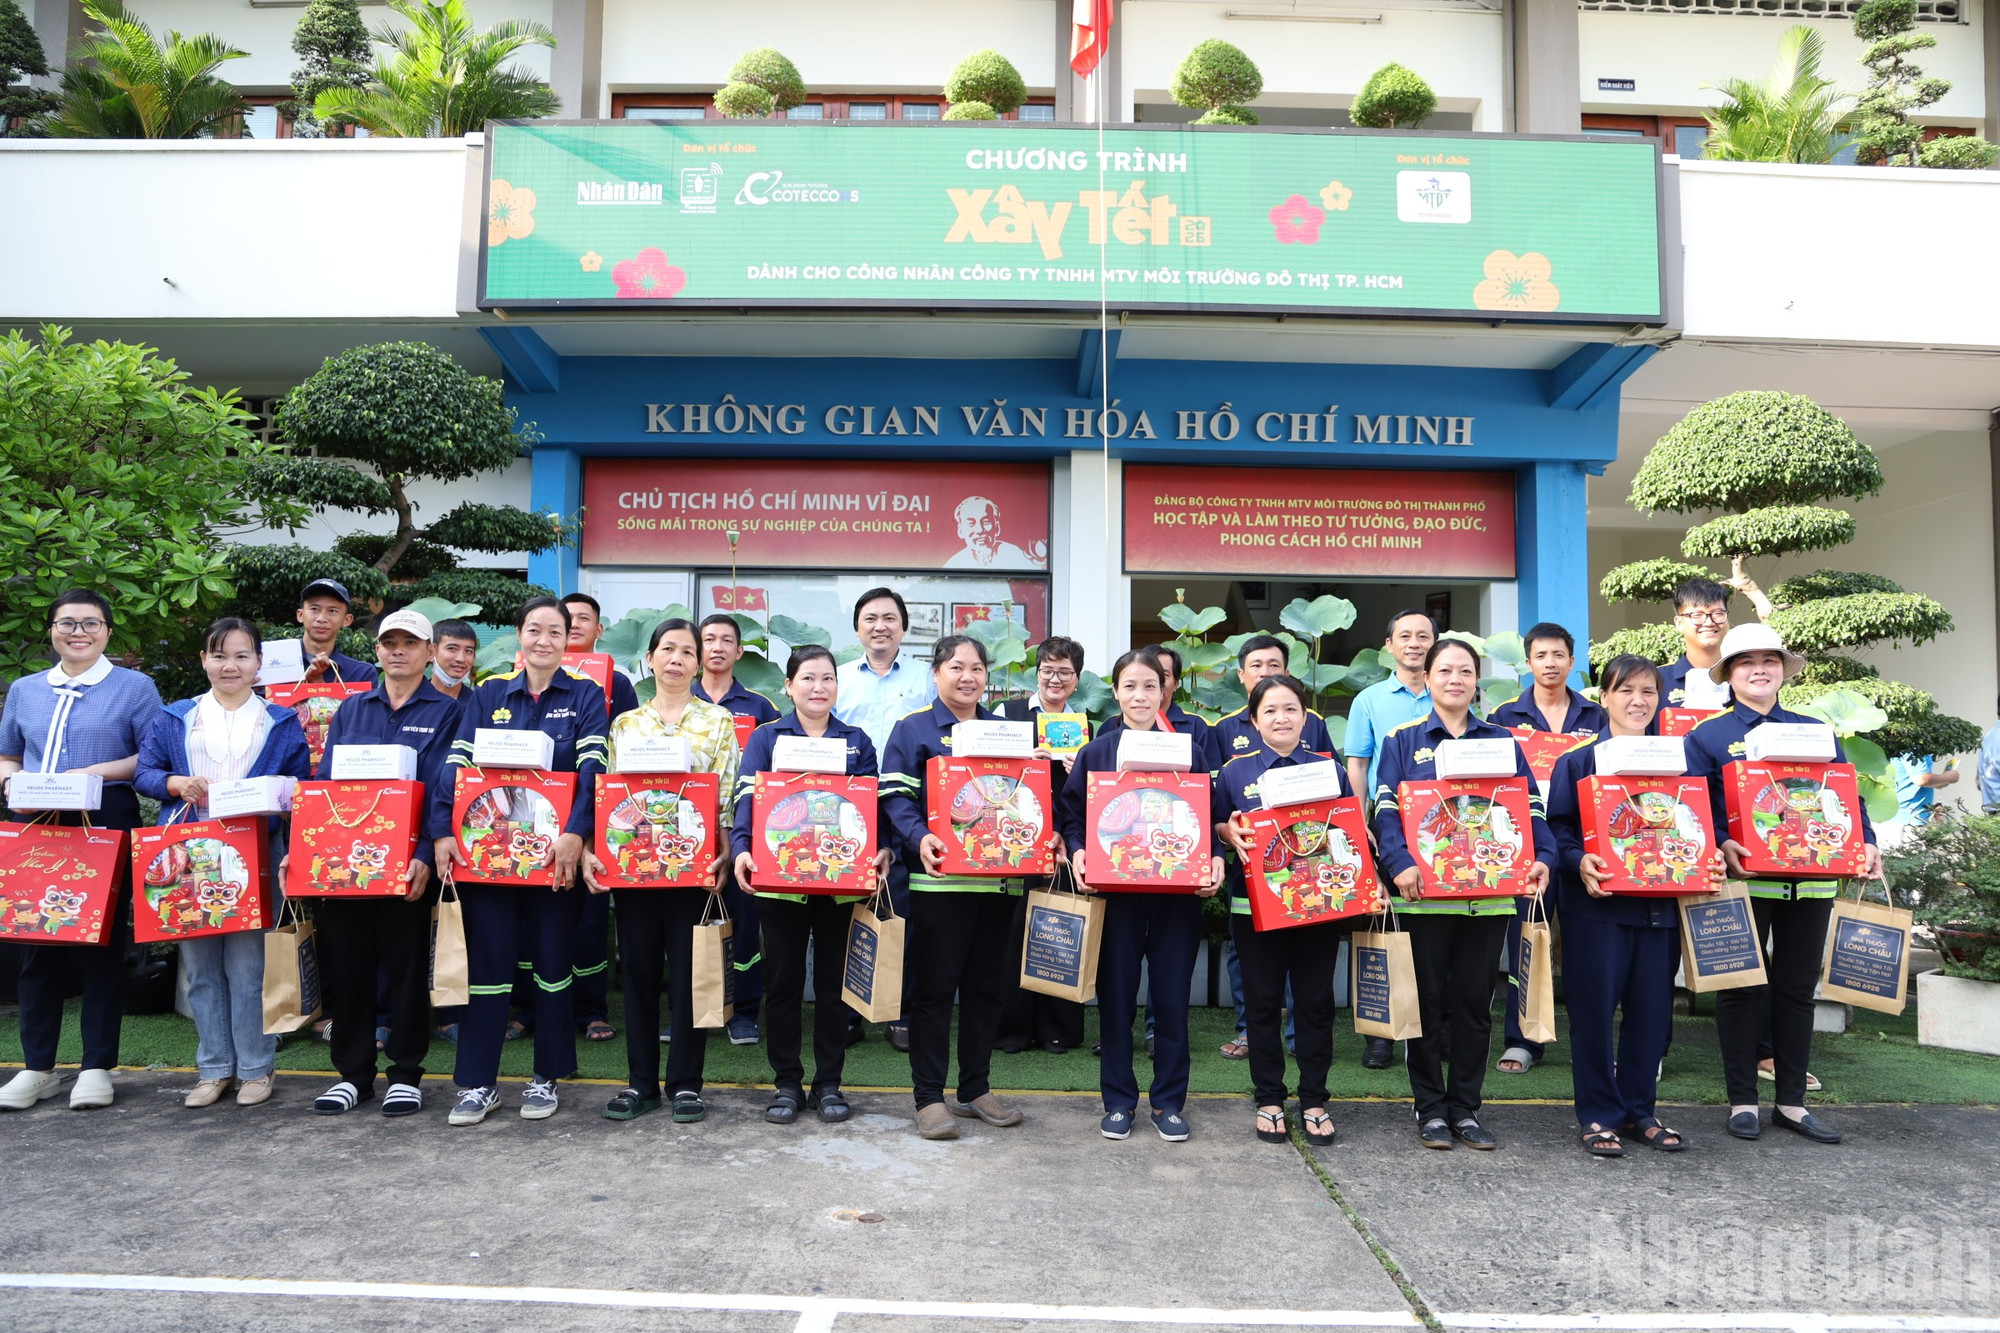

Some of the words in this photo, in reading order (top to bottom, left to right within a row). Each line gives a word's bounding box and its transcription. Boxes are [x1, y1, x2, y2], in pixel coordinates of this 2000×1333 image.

[682, 144, 704, 153] Đơn
[706, 144, 717, 155] vị
[719, 141, 731, 153] tổ
[733, 143, 757, 153] chức
[965, 147, 1088, 171] CHƯƠNG
[1096, 147, 1187, 172] TRÌNH
[577, 181, 625, 201] Nhân
[628, 181, 663, 201] Dân
[943, 183, 1073, 261] Xây
[1079, 180, 1177, 246] Tết
[747, 262, 798, 280] DÀNH
[802, 266, 841, 280] CHO
[845, 262, 898, 280] CÔNG
[903, 263, 955, 281] NHÂN
[959, 263, 1012, 281] CÔNG
[1018, 267, 1040, 281] TY
[1044, 267, 1095, 282] TNHH
[1101, 269, 1139, 283] MTV
[1144, 267, 1181, 284] MÔI
[1186, 267, 1262, 286] TRƯỜNG
[1266, 268, 1292, 286] ĐÔ
[1297, 272, 1330, 291] THỊ
[1335, 274, 1360, 288] TP.
[1365, 274, 1403, 289] HCM
[644, 393, 807, 435] KHÔNG
[825, 405, 942, 436] GIAN
[960, 398, 1048, 438] VĂN
[1063, 399, 1158, 440] HÓA
[1175, 401, 1240, 442] HỒ
[1255, 405, 1339, 443] CHÍ
[1353, 414, 1476, 446] MINH
[618, 487, 663, 510] CHỦ
[668, 492, 717, 514] TỊCH
[723, 488, 755, 510] HỒ
[760, 490, 797, 510] CHÍ
[802, 493, 860, 511] MINH
[865, 491, 887, 512] VĨ
[891, 495, 931, 517] ĐẠI
[1154, 494, 1186, 506] ĐẢNG
[1188, 496, 1205, 509] BỘ
[1206, 496, 1238, 508] CÔNG
[1240, 498, 1253, 508] TY
[1255, 498, 1286, 508] TNHH
[1288, 499, 1312, 508] MTV
[1314, 497, 1336, 509] MÔI
[1337, 498, 1383, 511] TRƯỜNG
[1385, 498, 1402, 511] ĐÔ
[1403, 501, 1422, 513] THỊ
[1423, 499, 1461, 511] THÀNH
[1463, 499, 1486, 512] PHỐ
[617, 516, 657, 531] SỐNG
[660, 517, 686, 531] MÃI
[689, 519, 738, 531] TRONG
[741, 519, 761, 535] SỰ
[763, 518, 816, 535] NGHIỆP
[820, 516, 849, 532] CỦA
[851, 517, 903, 533] CHÚNG
[905, 520, 923, 533] TA
[1153, 511, 1187, 529] HỌC
[1190, 510, 1218, 529] TẬP
[1221, 511, 1242, 526] VÀ
[1245, 511, 1279, 528] LÀM
[1282, 514, 1323, 528] THEO
[1325, 514, 1349, 528] TƯ
[1351, 512, 1410, 531] TƯỞNG,
[1413, 517, 1446, 533] ĐẠO
[1449, 514, 1487, 533] ĐỨC,
[1220, 533, 1276, 547] PHONG
[1279, 530, 1321, 548] CÁCH
[1325, 532, 1349, 548] HỒ
[1351, 532, 1378, 549] CHÍ
[1381, 536, 1422, 549] MINH
[1700, 926, 1721, 935] LONG
[1722, 923, 1742, 932] CHÂU
[1703, 918, 1715, 926] NHÀ
[1716, 916, 1735, 924] THUỐC
[1036, 932, 1054, 941] LONG
[1056, 935, 1074, 945] CHÂU
[1851, 936, 1863, 944] NHÀ
[1866, 939, 1887, 948] THUỐC
[1844, 942, 1867, 953] LONG
[1868, 947, 1892, 958] CHÂU
[1037, 969, 1049, 977] 1800
[1050, 972, 1064, 981] 6928
[1713, 963, 1728, 971] 1800
[1845, 979, 1860, 987] 1800
[1862, 983, 1880, 992] 6928
